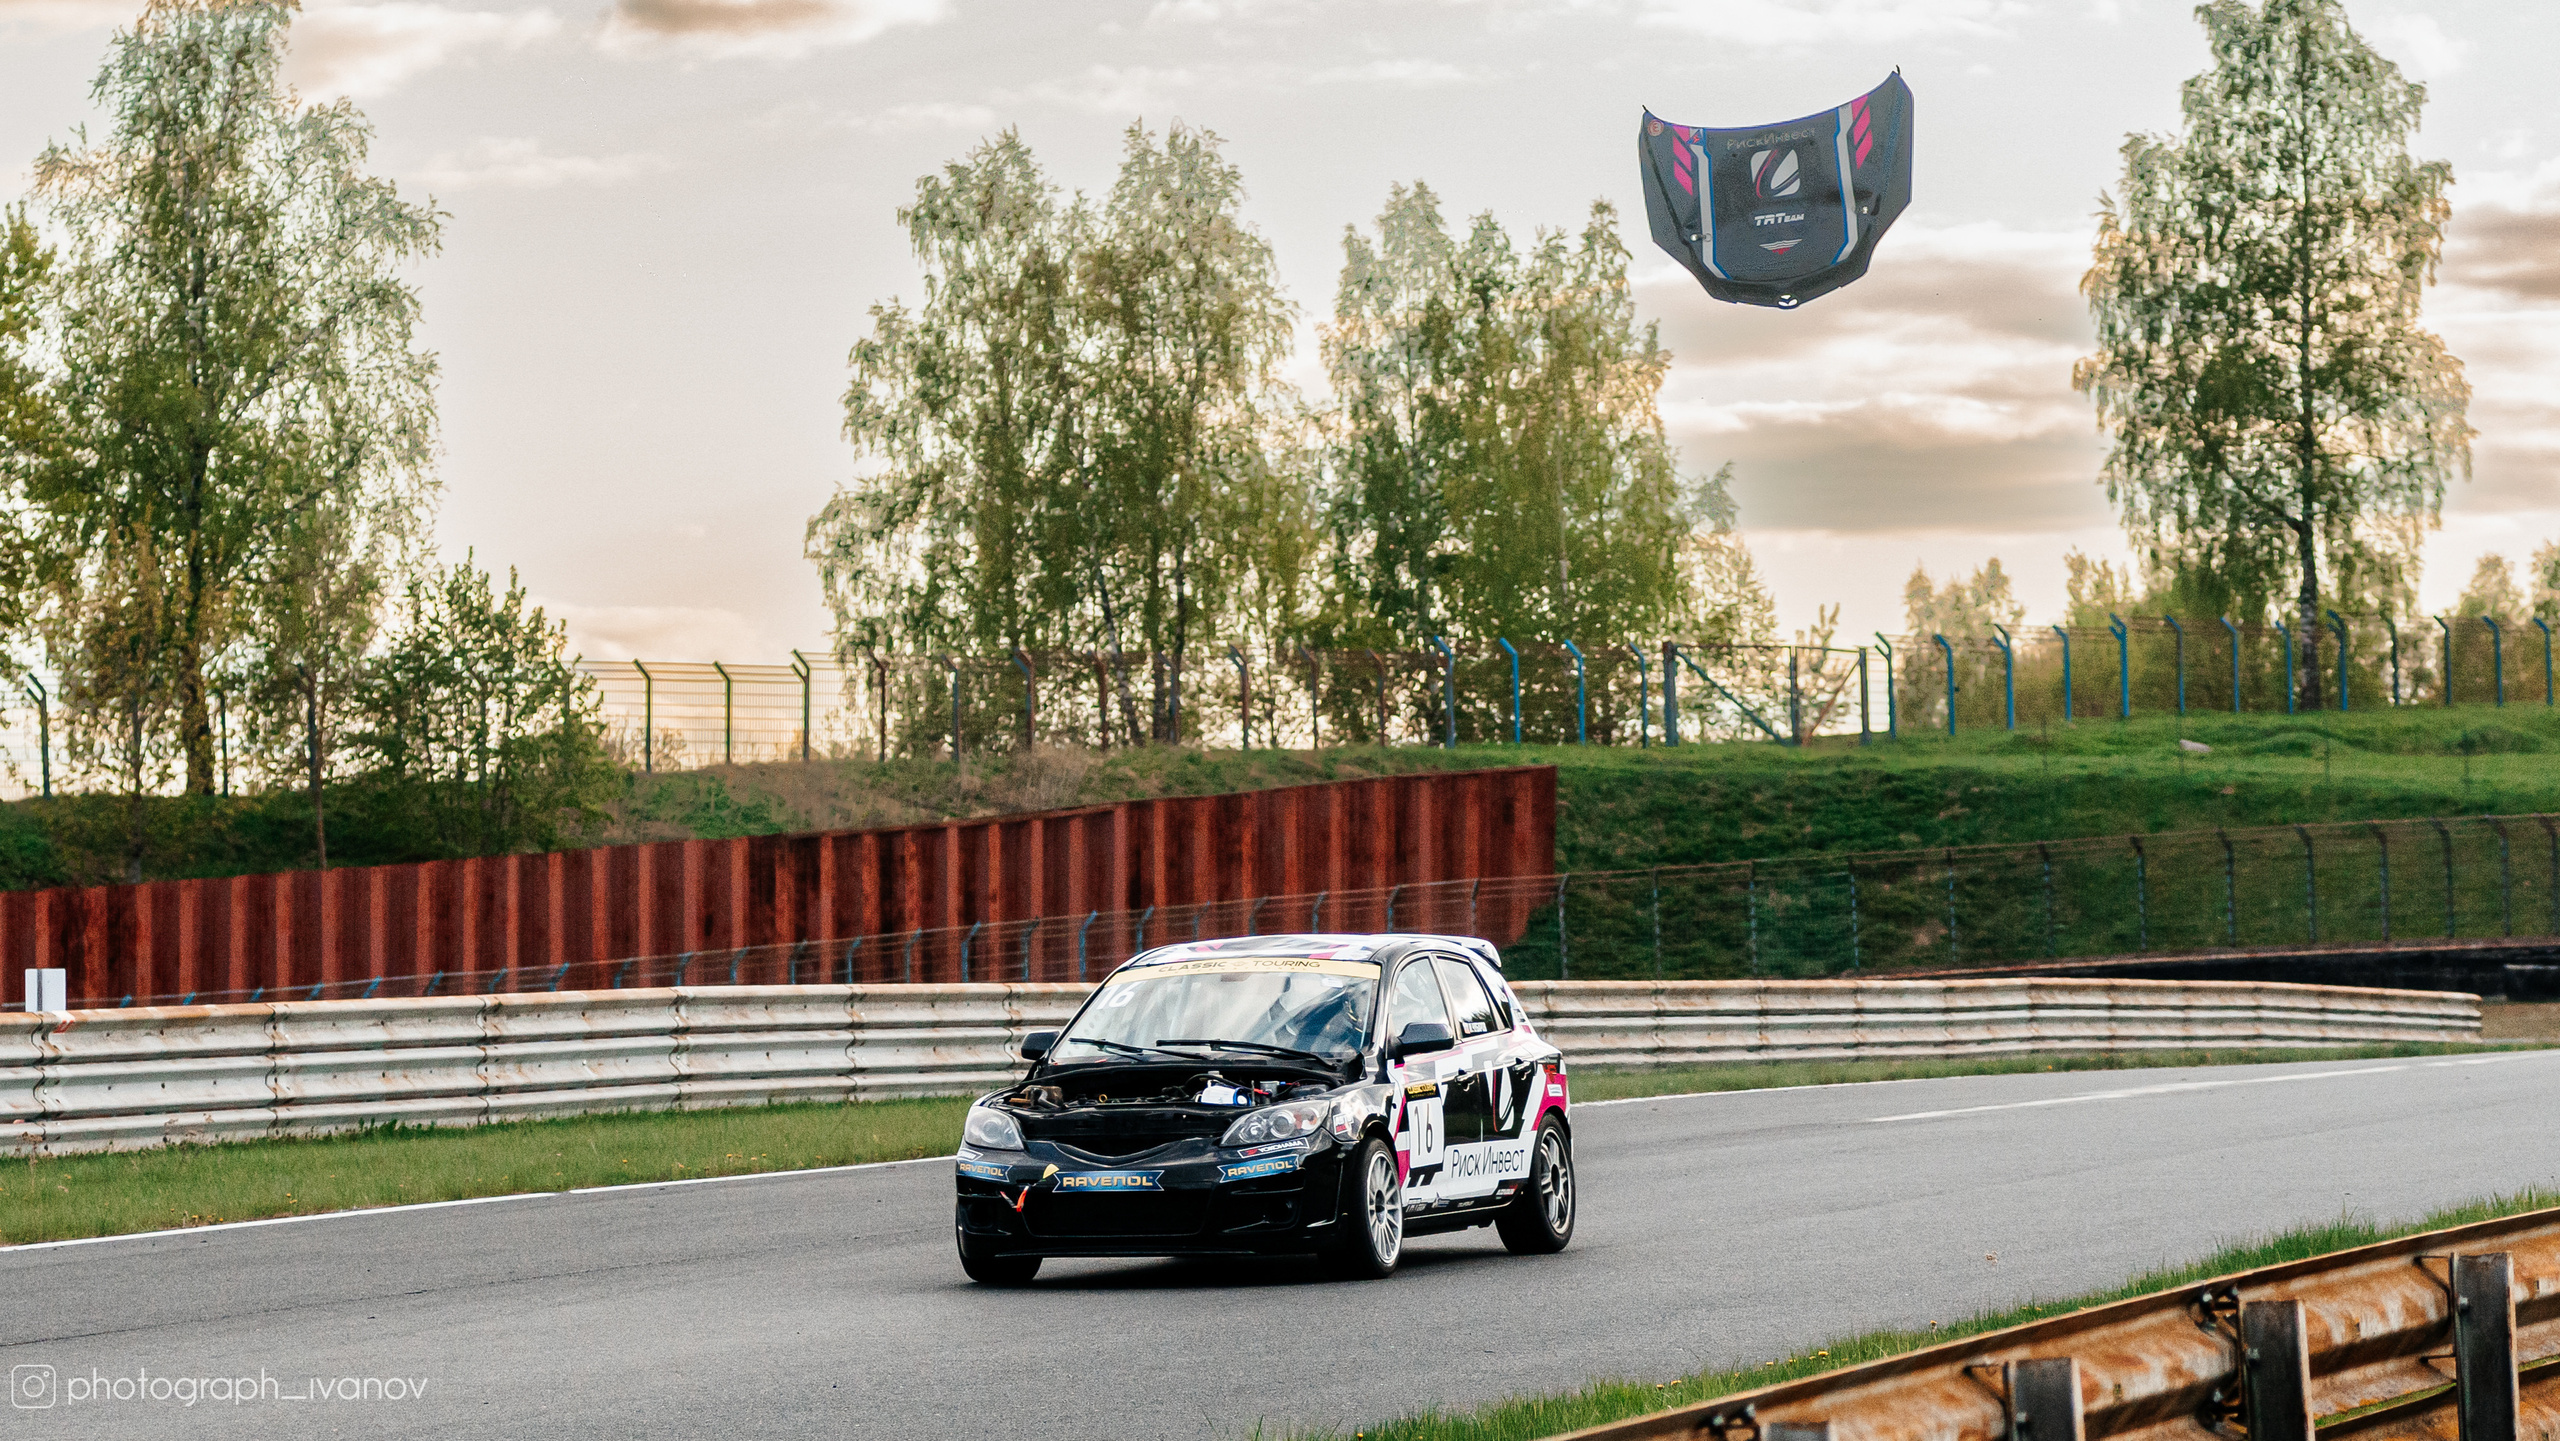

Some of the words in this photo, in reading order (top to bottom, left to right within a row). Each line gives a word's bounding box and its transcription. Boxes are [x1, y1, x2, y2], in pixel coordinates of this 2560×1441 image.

[1158, 960, 1226, 973] CLASSIC
[1253, 960, 1321, 968] TOURING
[1096, 980, 1147, 1010] 16
[1414, 1102, 1434, 1157] 16
[1259, 1140, 1304, 1153] YOKOHAMA
[959, 1163, 1005, 1177] RAVENOL
[1227, 1160, 1294, 1177] RAVENOL
[1062, 1176, 1154, 1187] RAVENOL
